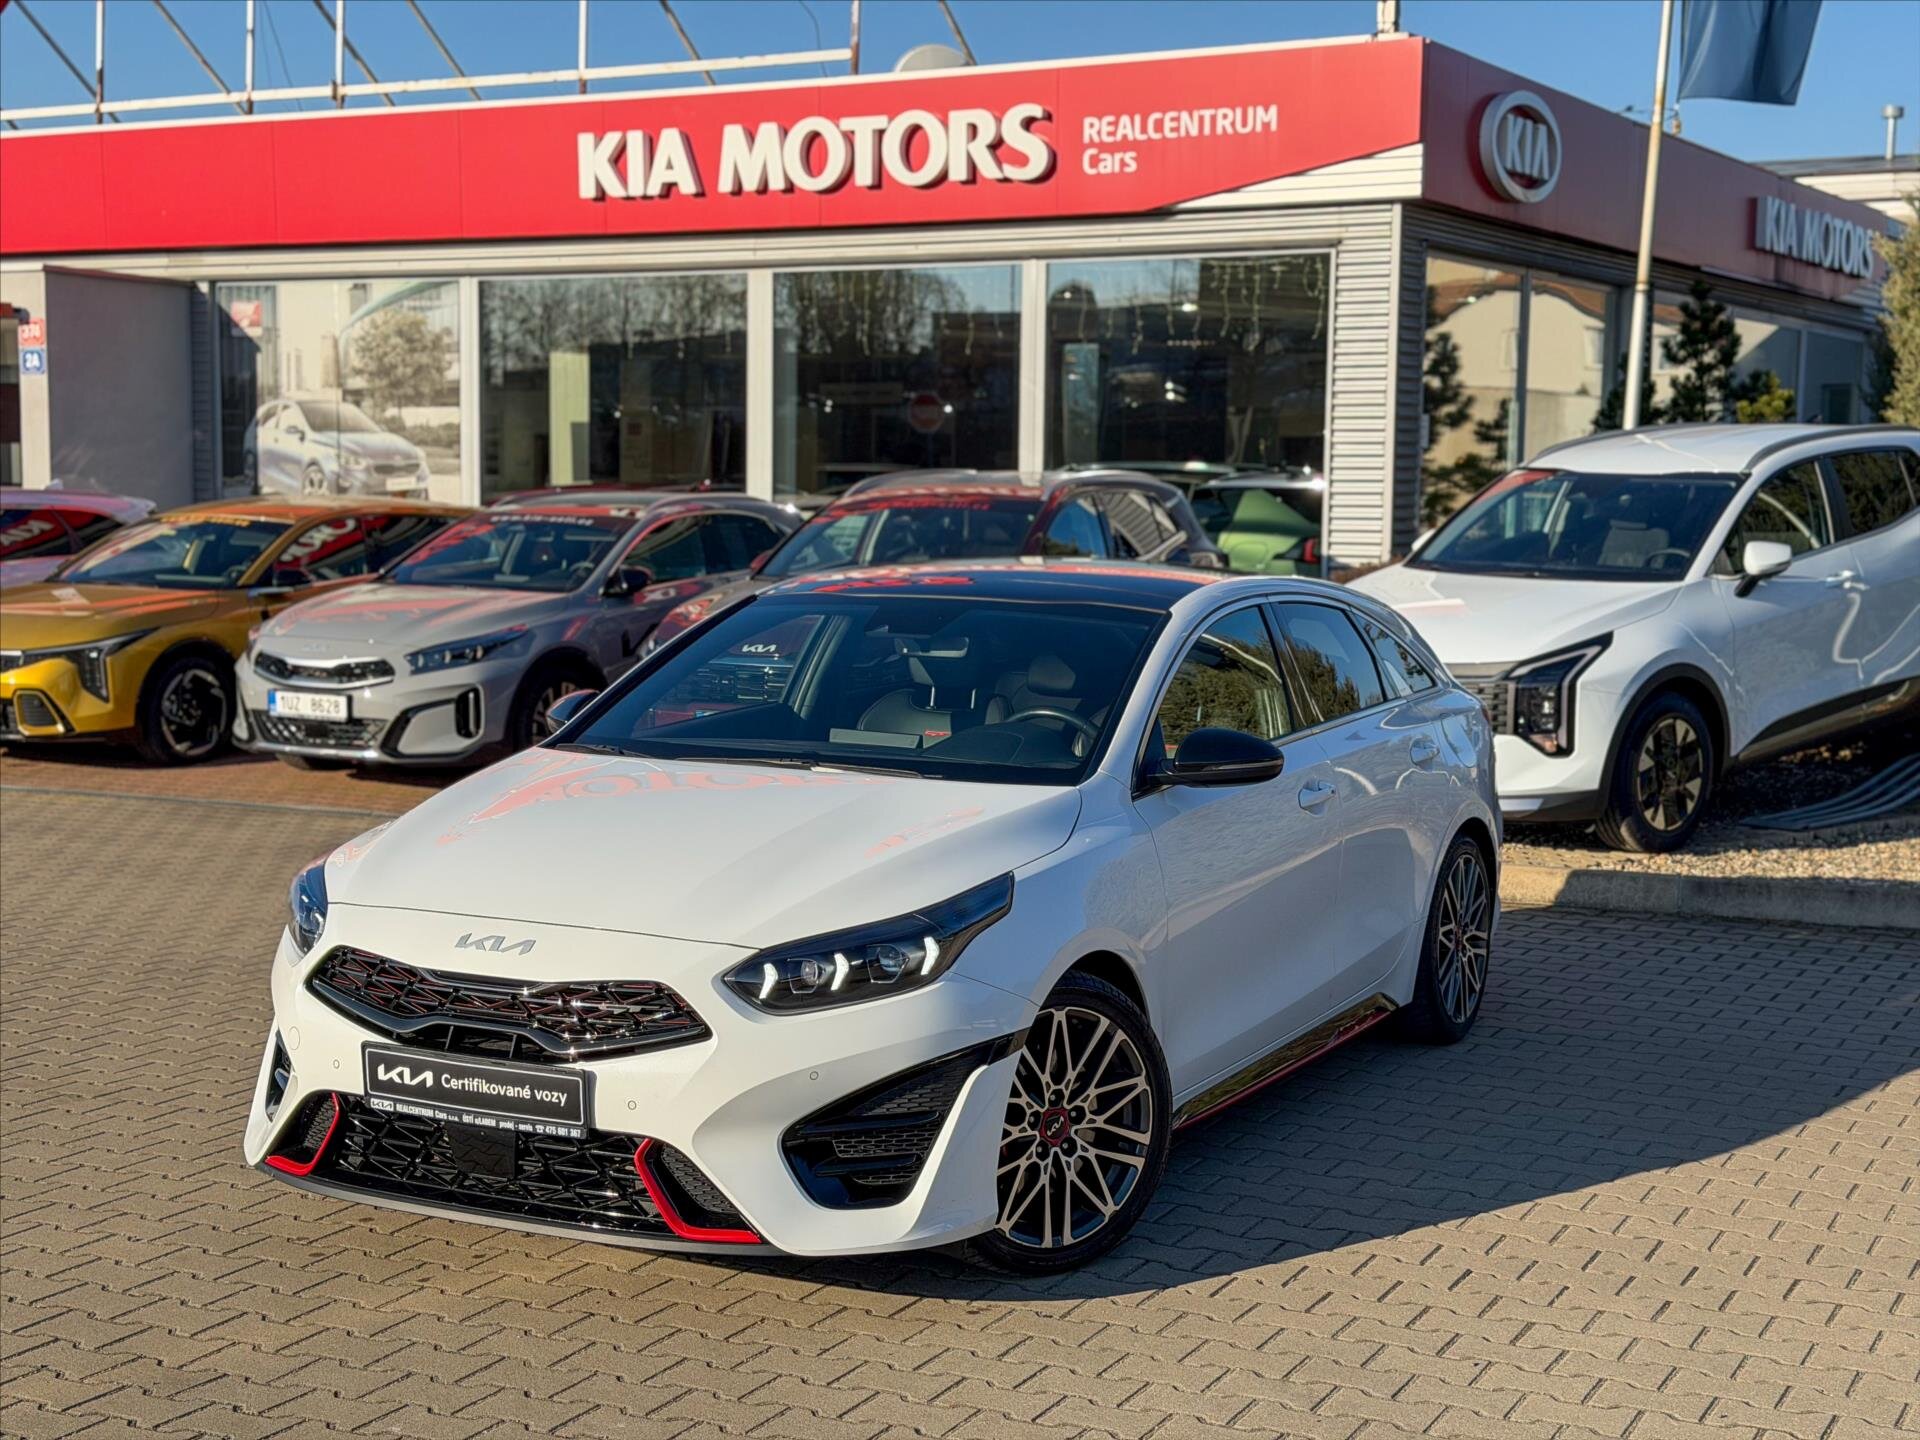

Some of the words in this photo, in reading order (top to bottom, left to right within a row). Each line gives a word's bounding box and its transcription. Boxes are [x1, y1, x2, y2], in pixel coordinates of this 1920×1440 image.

[1082, 104, 1278, 144] REALCENTRUM
[578, 127, 700, 199] KIA
[717, 102, 1052, 194] MOTORS
[1082, 147, 1138, 175] Cars
[1505, 113, 1550, 180] KIA
[1762, 195, 1799, 259] KIA
[1802, 208, 1873, 279] MOTORS
[280, 695, 301, 711] 1UZ
[454, 932, 537, 956] KIA
[377, 1063, 434, 1089] KIA
[441, 1073, 532, 1099] Certifikované
[534, 1091, 568, 1107] vozy
[395, 1103, 435, 1118] REALCENTRUM
[434, 1110, 448, 1120] Cars
